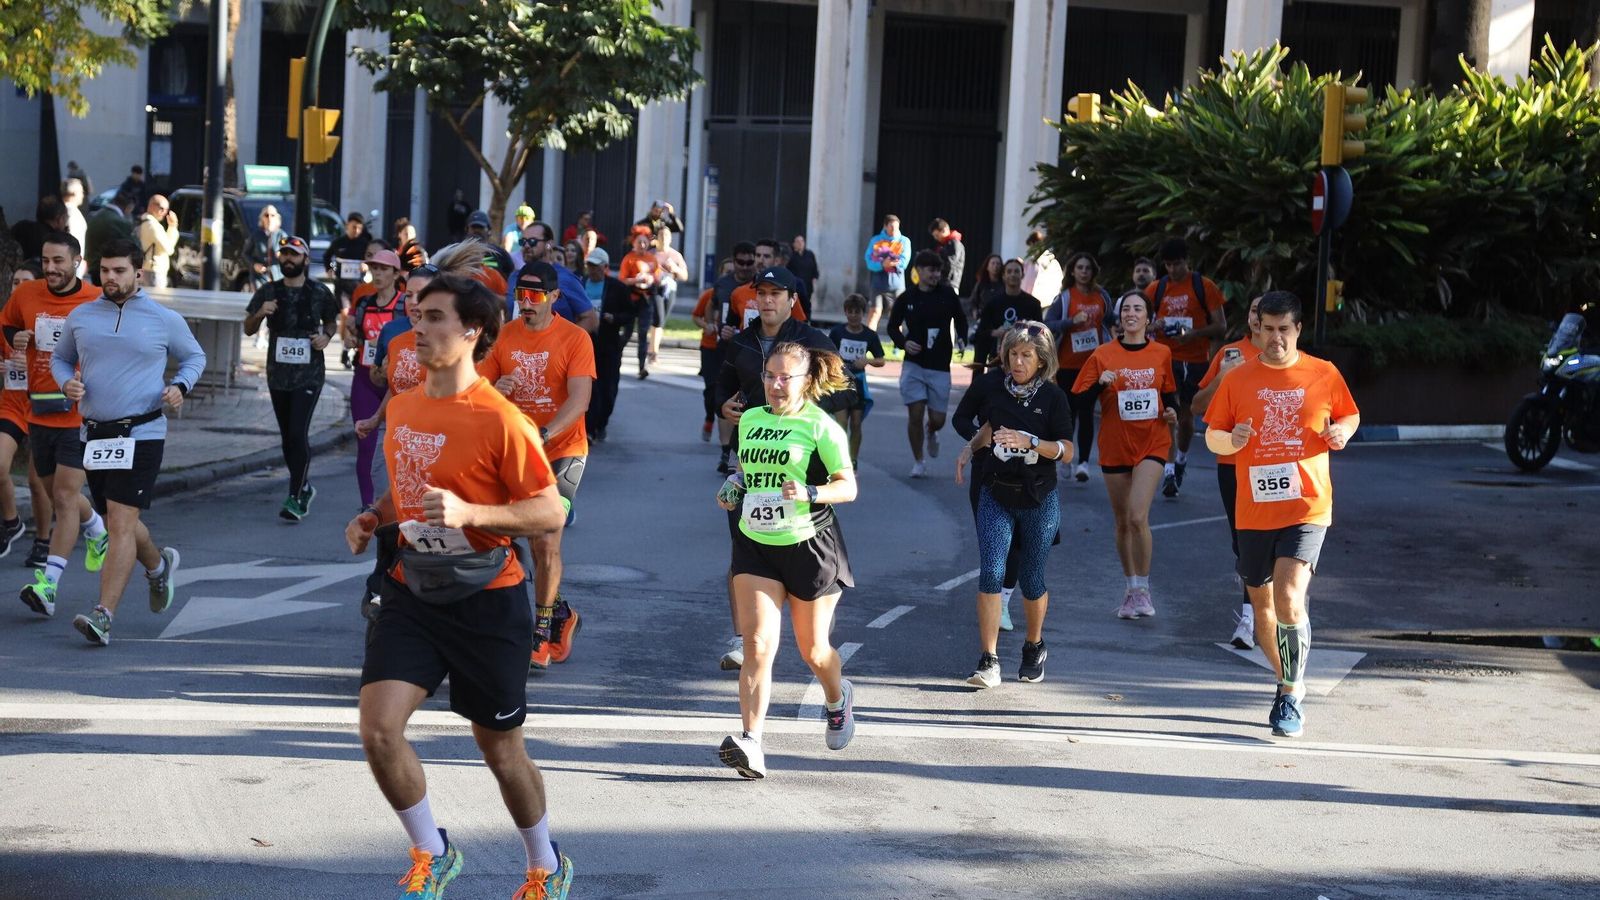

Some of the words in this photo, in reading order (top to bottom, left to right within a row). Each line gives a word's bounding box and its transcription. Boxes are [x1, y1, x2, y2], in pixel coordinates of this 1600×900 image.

[281, 346, 304, 356] 548
[1124, 400, 1151, 411] 867
[745, 426, 792, 441] LARRY
[92, 448, 125, 460] 579
[740, 447, 790, 466] MUCHO
[745, 472, 787, 489] BETIS
[1257, 476, 1291, 492] 356
[750, 505, 785, 521] 431
